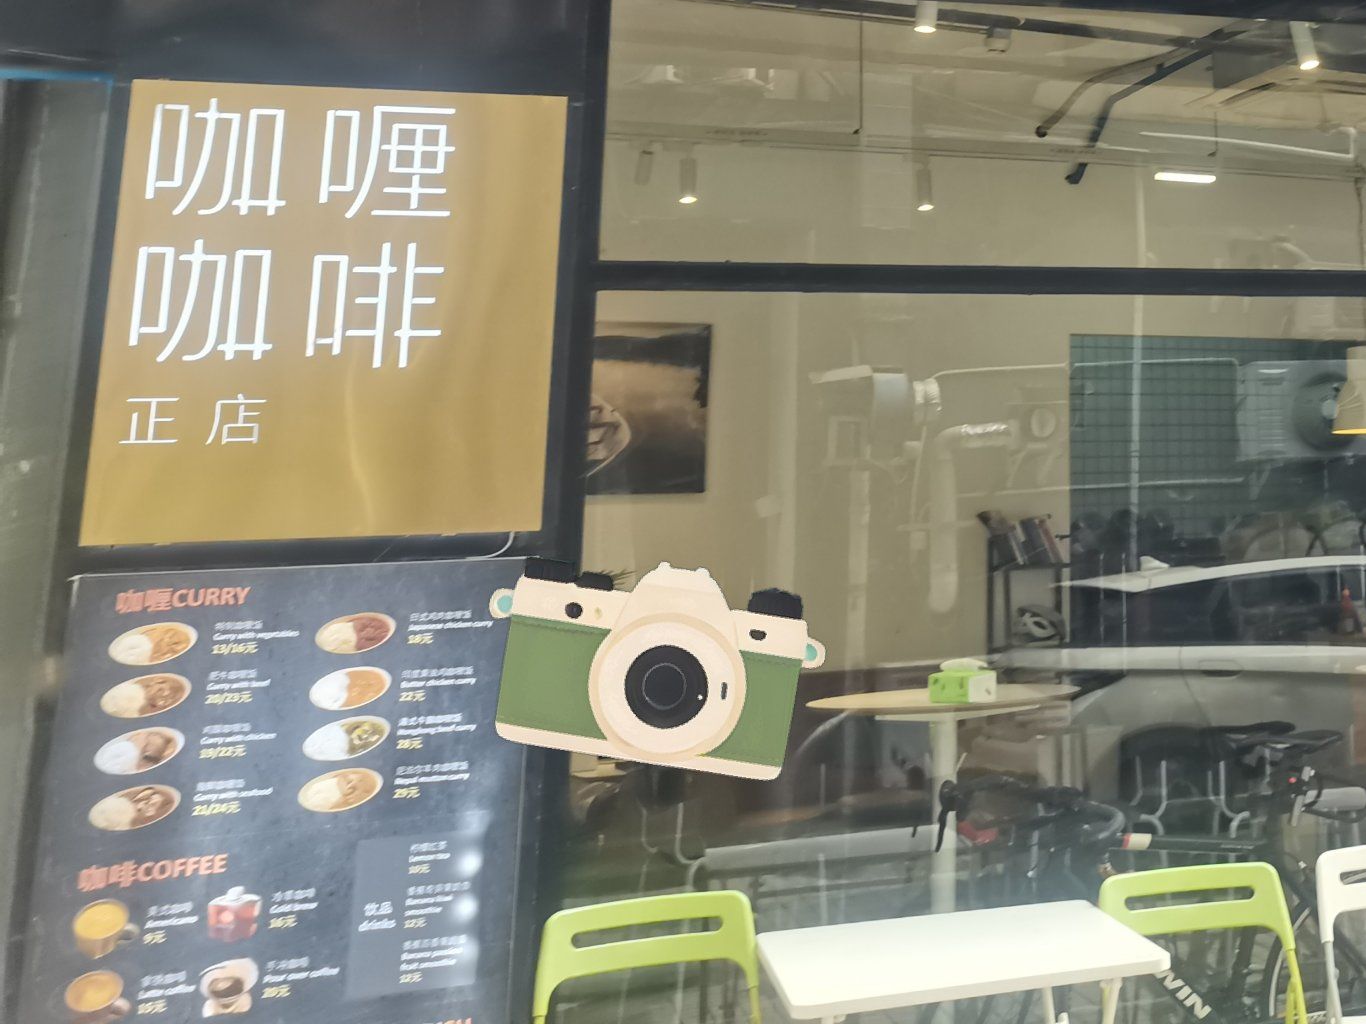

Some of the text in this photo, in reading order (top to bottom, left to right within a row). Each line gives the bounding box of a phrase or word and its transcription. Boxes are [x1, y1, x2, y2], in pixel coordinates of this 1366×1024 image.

[145, 98, 456, 218] 咖喱
[128, 238, 445, 368] 咖啡
[118, 393, 268, 445] 正店
